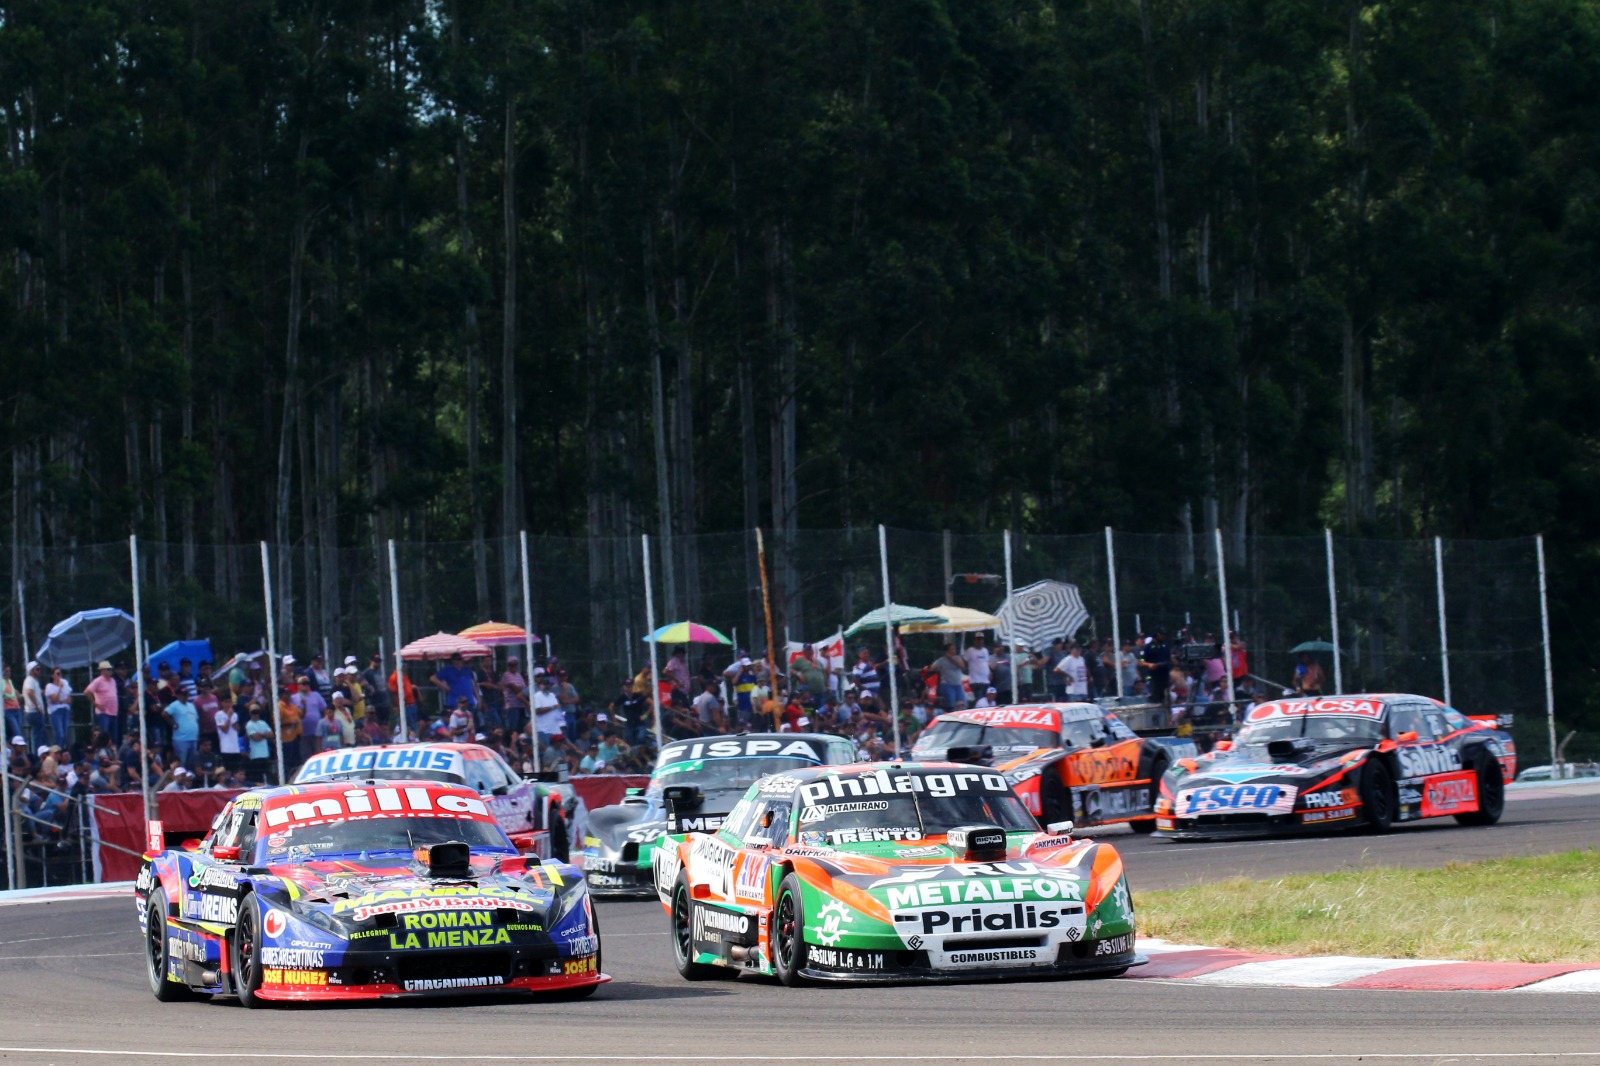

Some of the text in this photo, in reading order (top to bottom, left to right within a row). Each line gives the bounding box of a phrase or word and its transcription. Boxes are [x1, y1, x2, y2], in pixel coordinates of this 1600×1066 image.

[1285, 700, 1375, 714] TACSA
[299, 750, 454, 780] ALLOCHIS
[657, 740, 821, 768] FISPA
[800, 769, 1009, 807] philagro
[265, 787, 489, 828] milla
[827, 801, 888, 813] ALTAMIRANO
[1186, 785, 1281, 814] ESCO
[826, 829, 922, 846] TRENTO
[333, 886, 545, 914] MANNOL
[886, 878, 1082, 910] METALFOR
[404, 911, 492, 930] ROMAN
[528, 924, 543, 932] AIRES
[704, 910, 749, 934] ALTAMIRANO
[922, 903, 1060, 934] Prialis
[291, 939, 332, 950] CIPOLLETTI
[350, 928, 389, 940] PELLEGRINI
[390, 928, 512, 950] LA MENZA
[279, 948, 325, 968] ARGENTINAS
[950, 950, 1037, 964] COMBUSTIBLES
